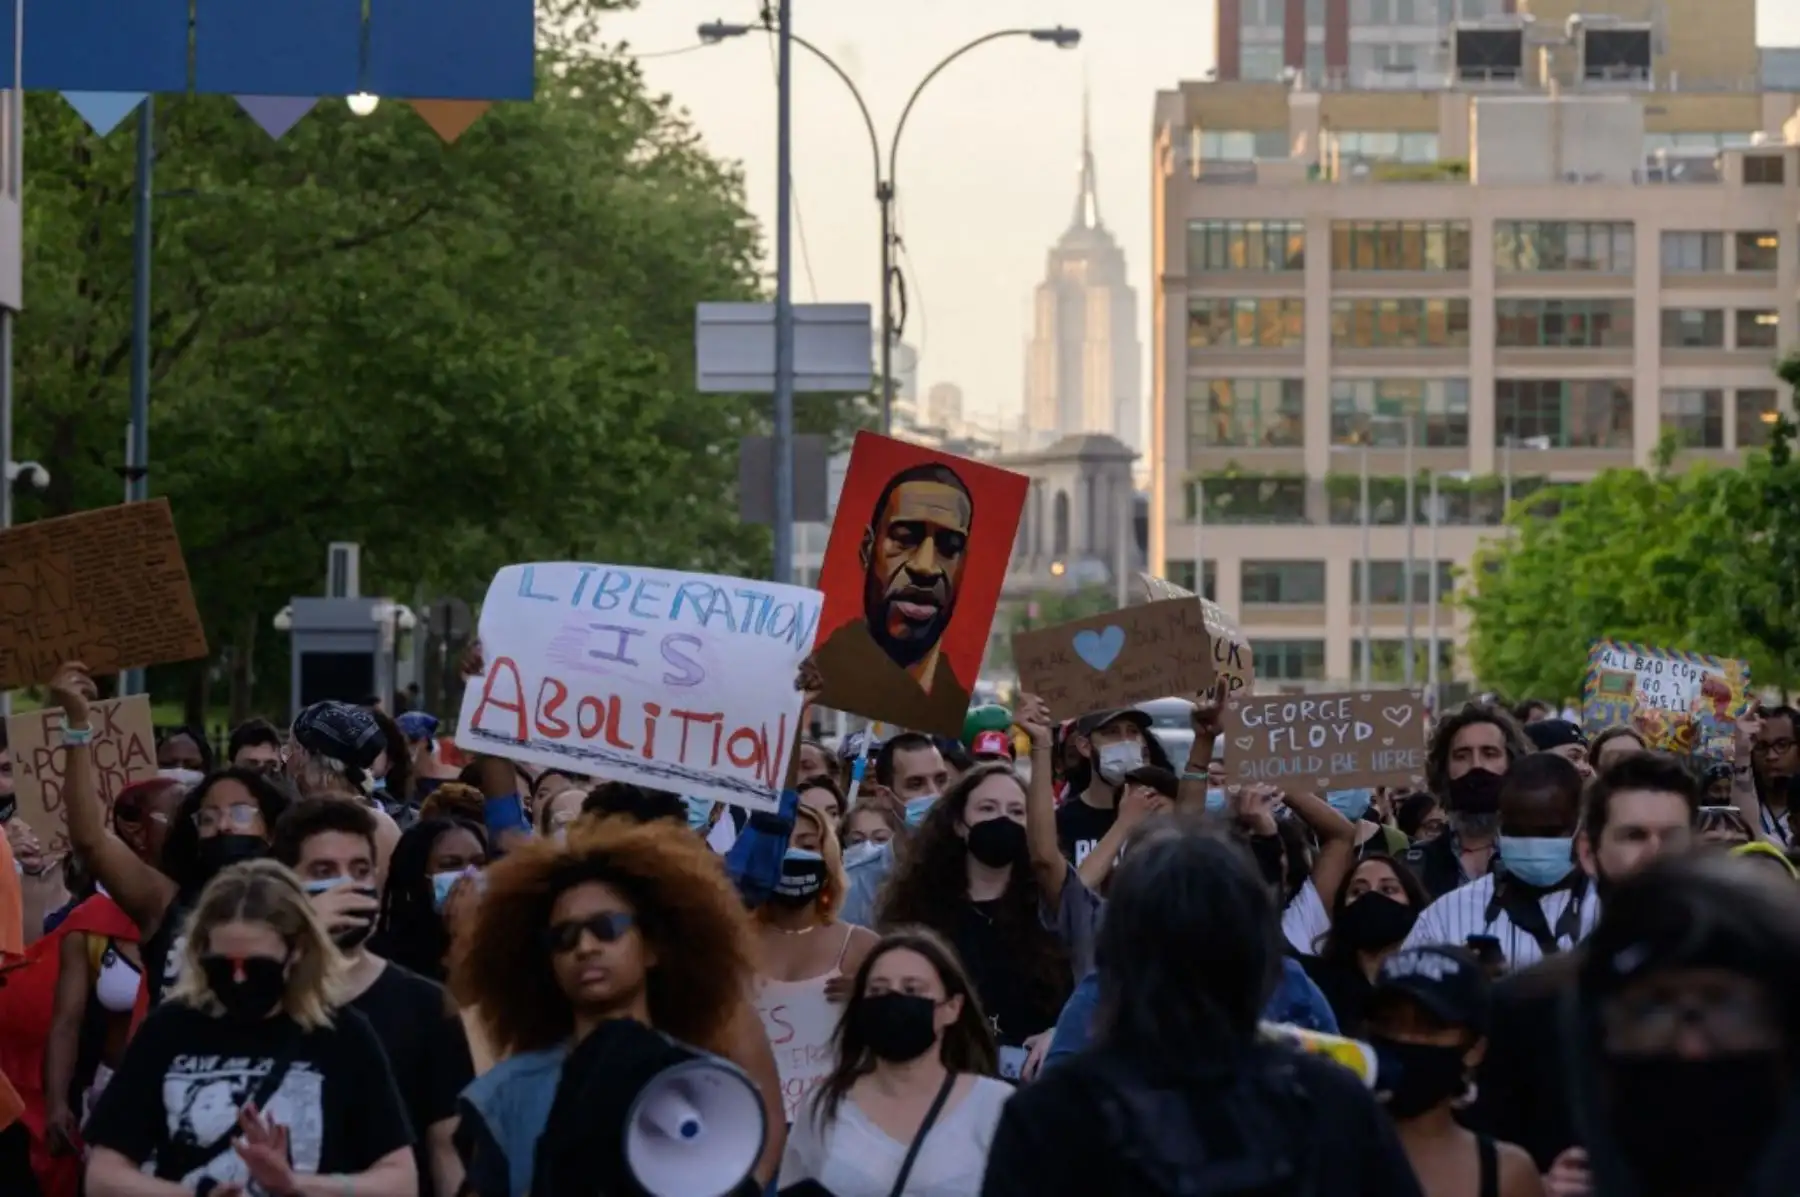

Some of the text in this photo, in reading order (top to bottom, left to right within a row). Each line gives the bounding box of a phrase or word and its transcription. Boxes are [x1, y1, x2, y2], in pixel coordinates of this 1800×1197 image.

[517, 565, 819, 651] LIBERATION
[588, 622, 706, 688] IS
[1602, 650, 1708, 685] ALL BAD COPS
[1642, 678, 1660, 693] GO
[1241, 697, 1352, 727] GEORGE
[1648, 695, 1686, 713] HELL
[41, 701, 124, 748] FCK
[1268, 721, 1374, 753] FLOYD
[33, 731, 153, 782] POICIA
[1238, 749, 1422, 779] SHOULD BE HERE
